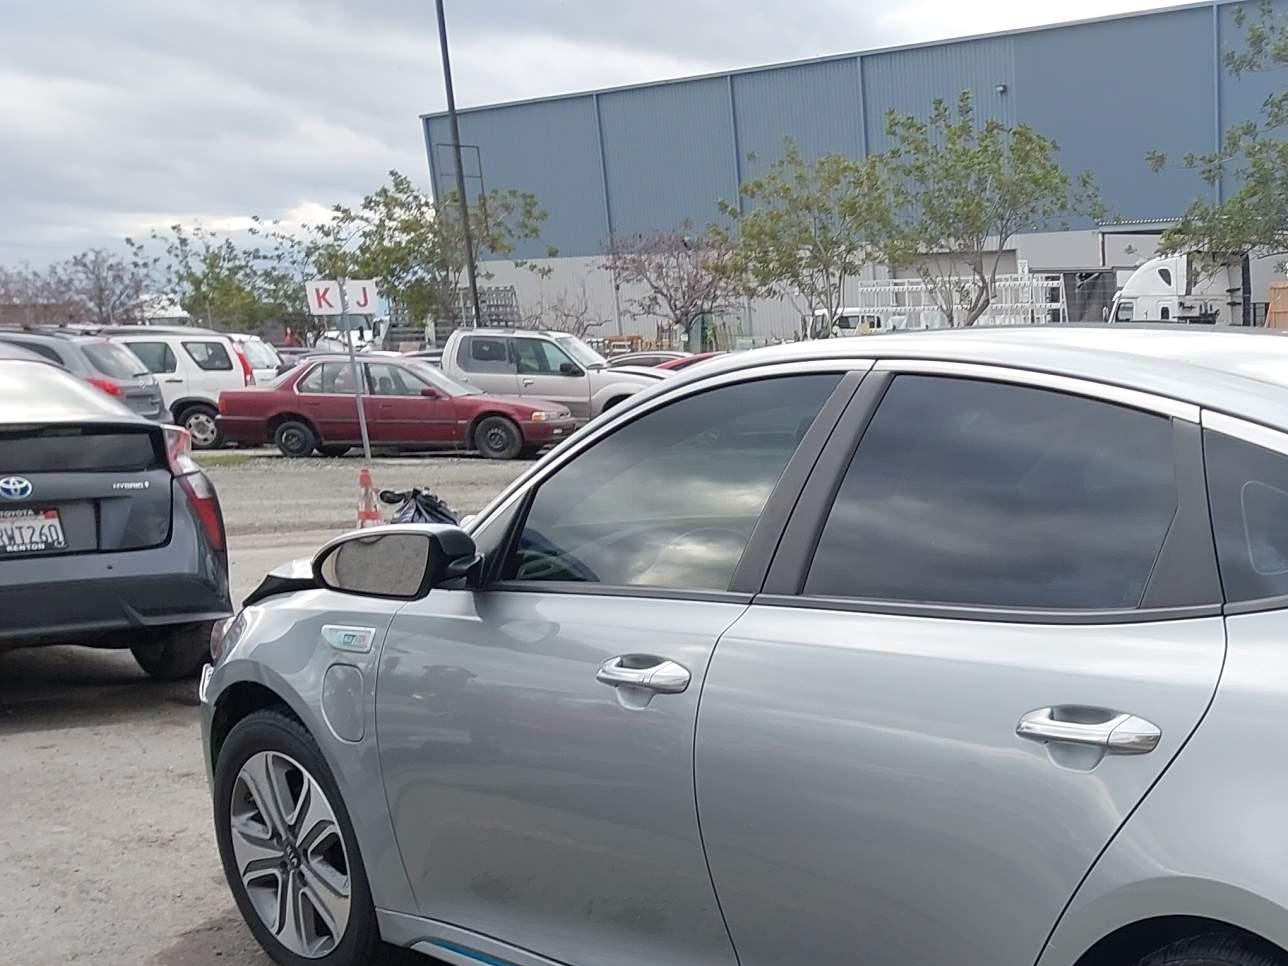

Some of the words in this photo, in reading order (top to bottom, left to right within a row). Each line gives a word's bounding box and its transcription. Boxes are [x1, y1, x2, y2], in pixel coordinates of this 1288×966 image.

[314, 287, 335, 309] K
[356, 287, 369, 308] J
[112, 481, 144, 489] HYBRID
[287, 845, 298, 867] KIA
